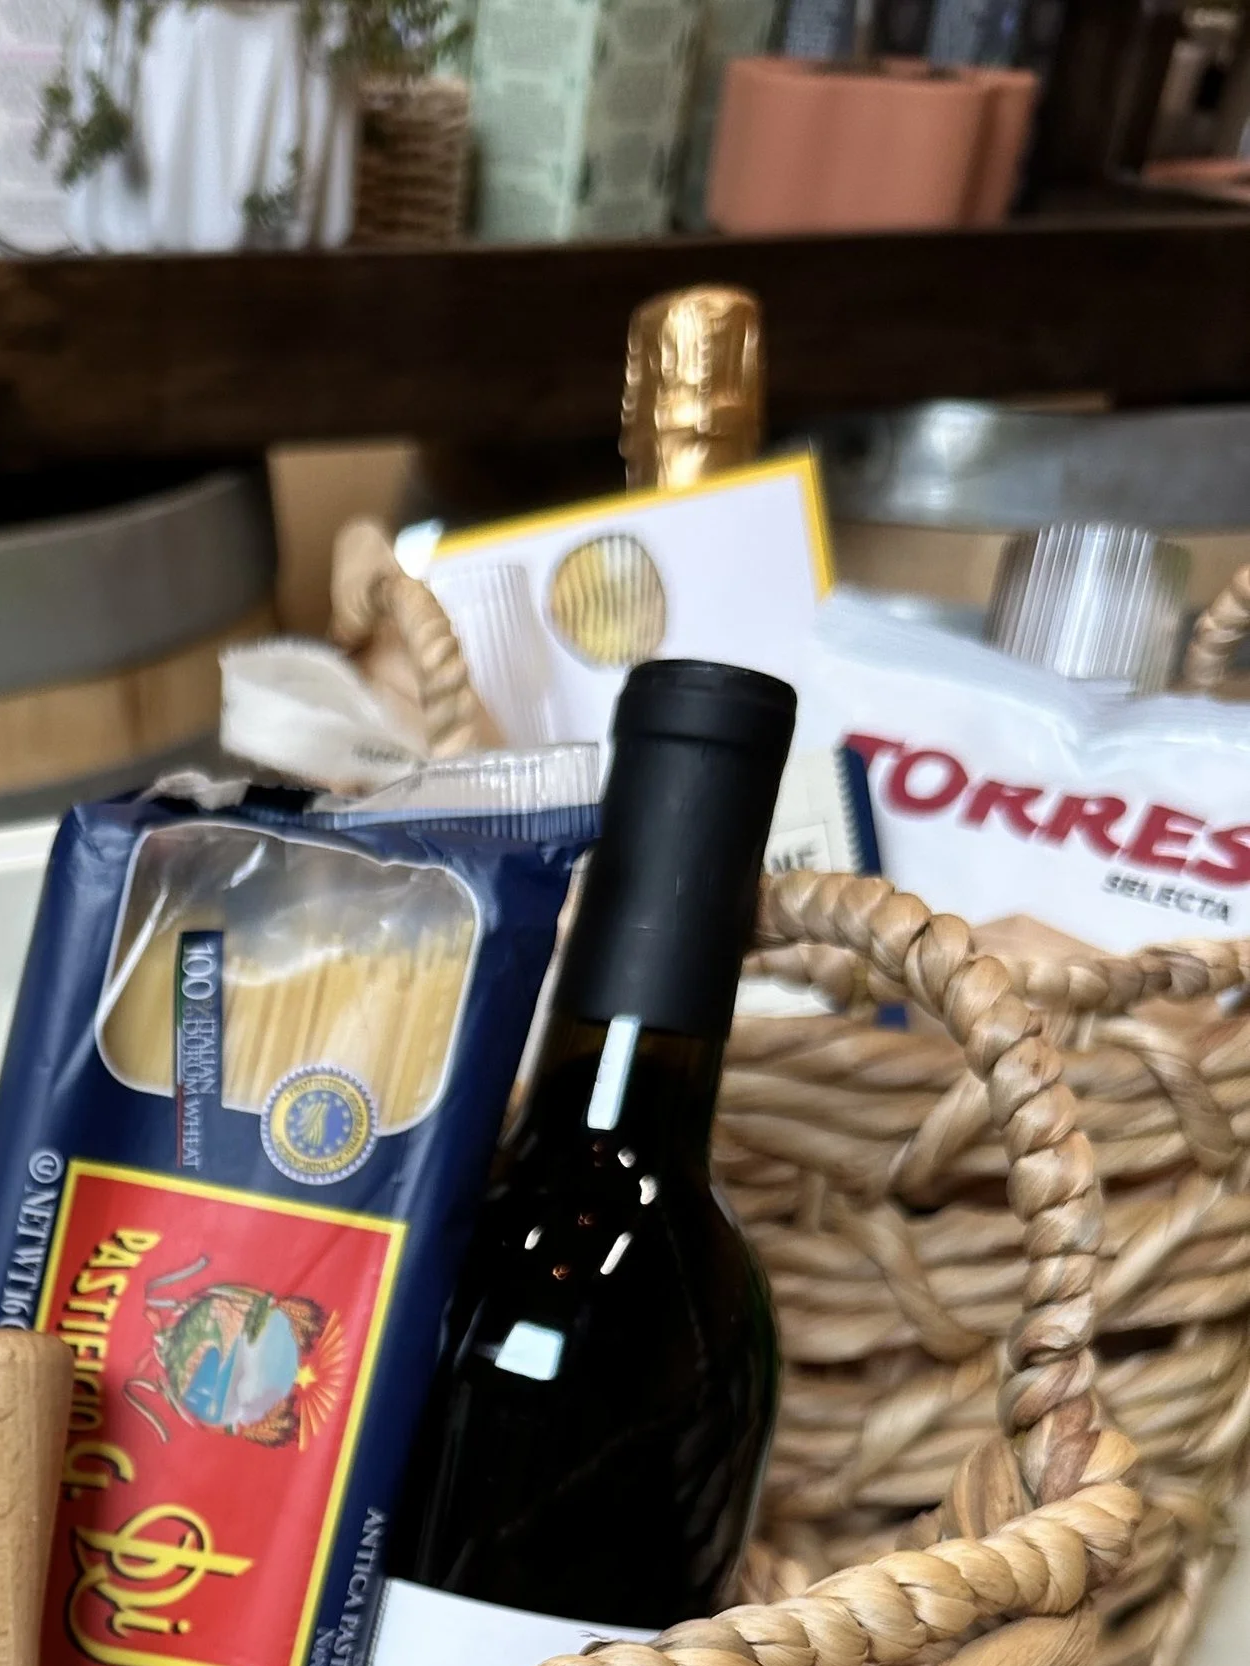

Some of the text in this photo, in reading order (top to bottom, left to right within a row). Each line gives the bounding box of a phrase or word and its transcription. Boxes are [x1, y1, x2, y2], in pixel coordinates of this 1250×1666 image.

[1101, 871, 1232, 922] SELECTA
[181, 1098, 200, 1171] WHEAT
[343, 1505, 387, 1610] ANTICA
